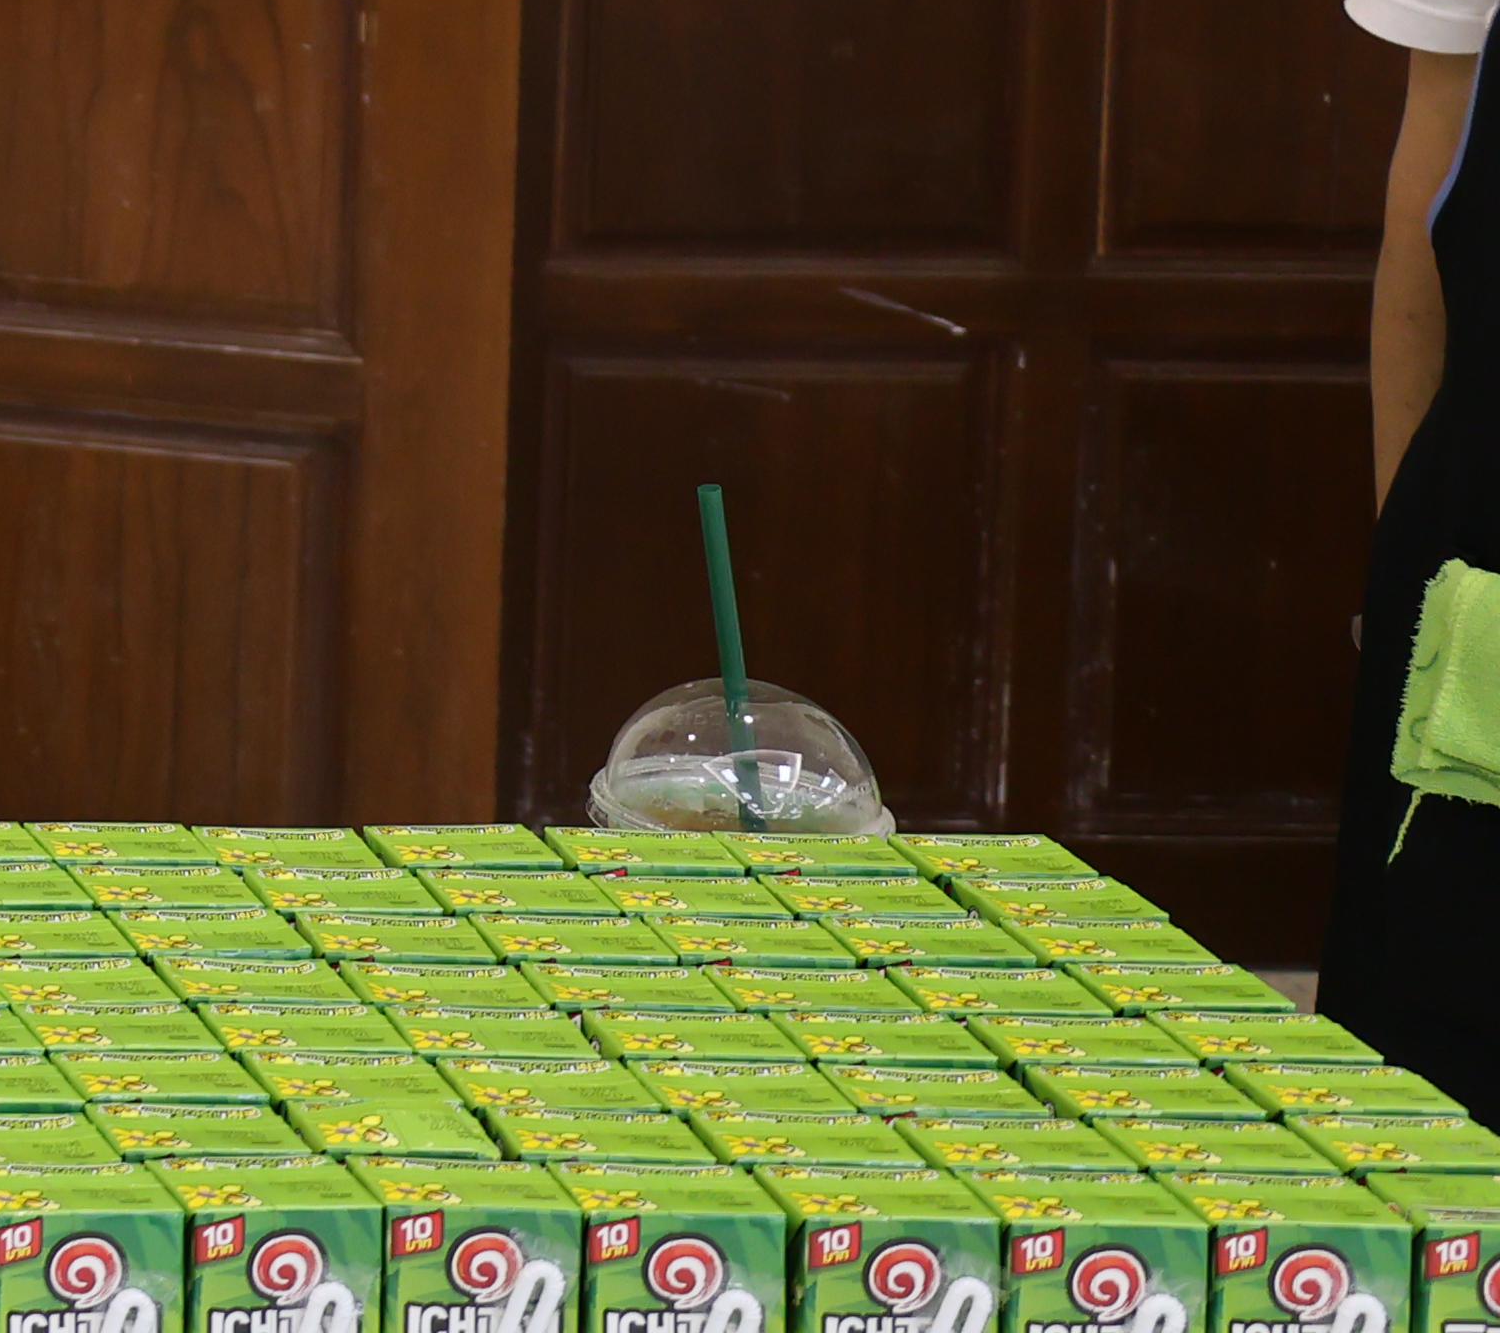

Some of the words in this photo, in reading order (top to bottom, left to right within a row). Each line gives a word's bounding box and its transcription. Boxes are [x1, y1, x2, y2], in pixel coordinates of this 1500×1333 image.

[1, 1225, 32, 1248] 10
[203, 1225, 234, 1247] 10
[401, 1217, 433, 1240] 10
[596, 1224, 628, 1247] 10
[818, 1229, 849, 1252] 10
[1021, 1235, 1053, 1258] 10
[1225, 1234, 1257, 1258] 10
[1435, 1240, 1468, 1262] 10
